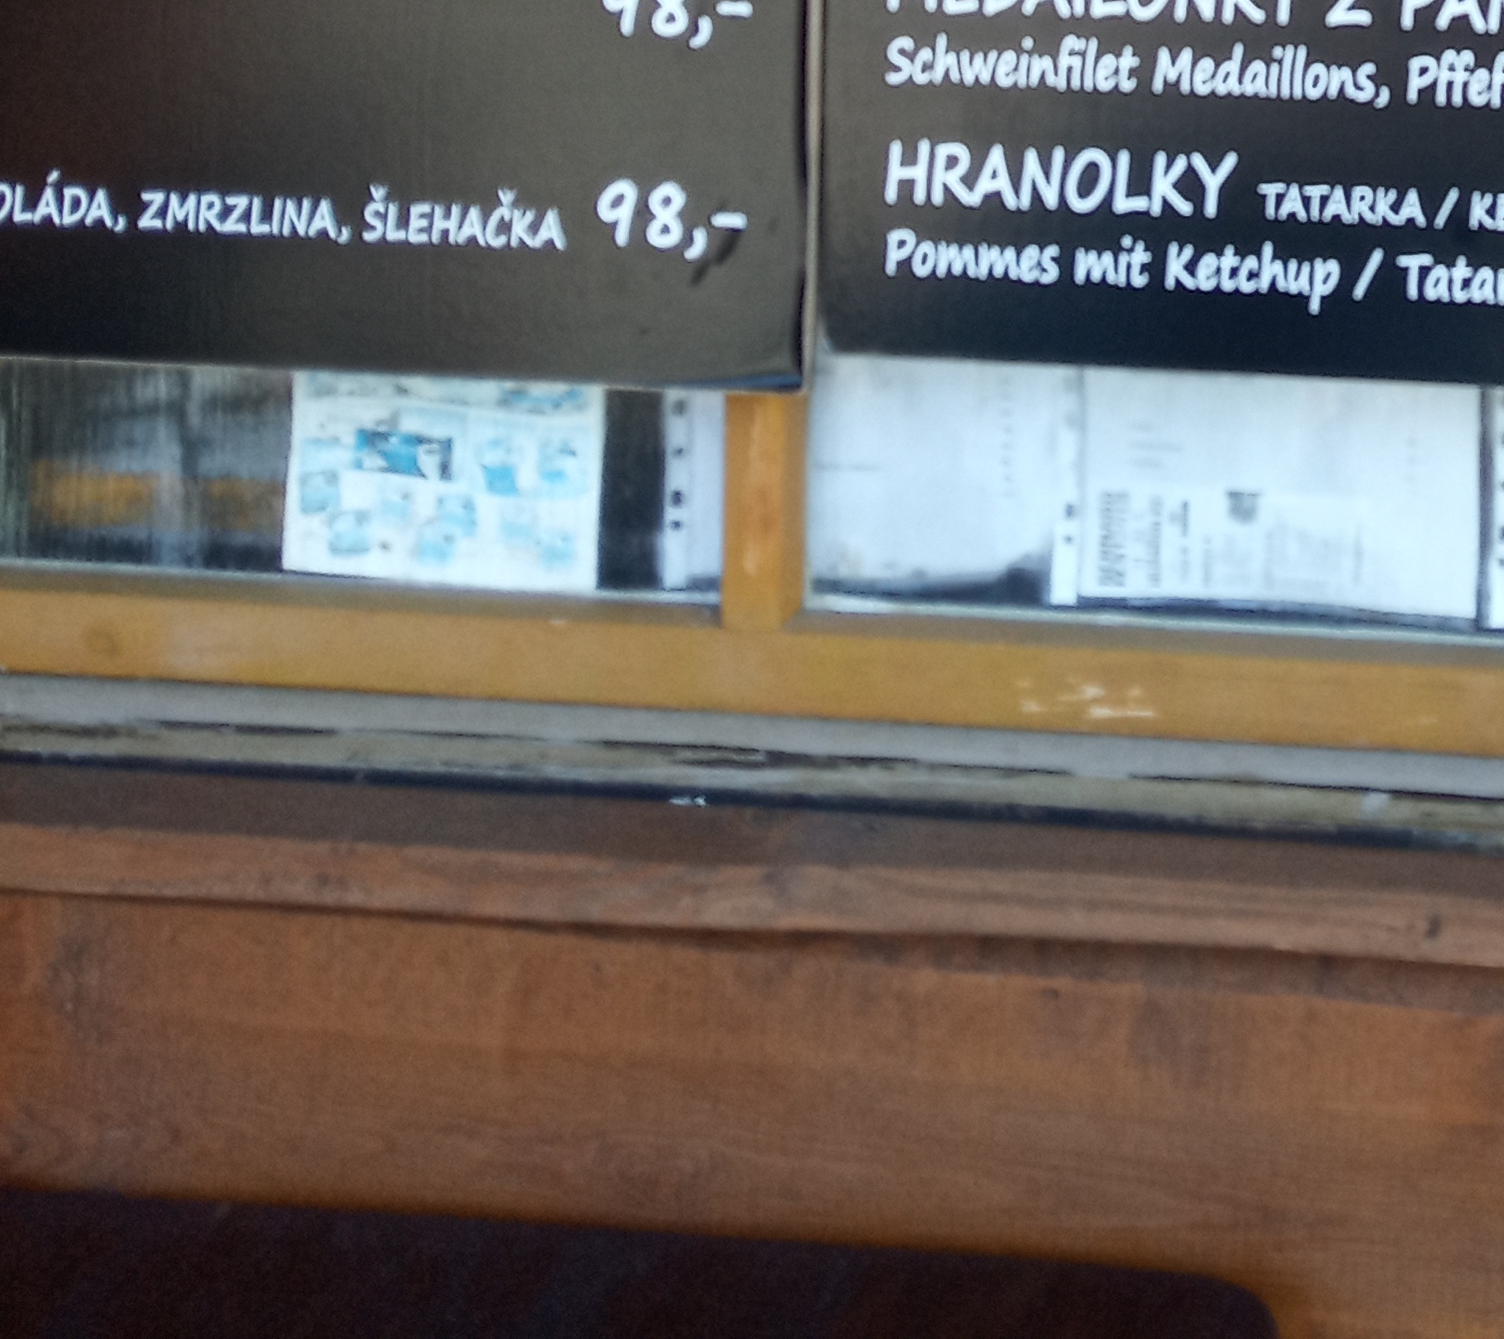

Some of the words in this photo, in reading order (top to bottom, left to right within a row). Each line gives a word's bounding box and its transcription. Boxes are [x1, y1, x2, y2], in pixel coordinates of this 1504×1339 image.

[884, 32, 1141, 93] Schweinfilet
[1151, 42, 1391, 109] Medaillons,
[136, 189, 352, 245] ZMRZLINA,
[361, 184, 567, 251] ŠLEHAČKA
[596, 178, 749, 261] 98,-
[883, 138, 1239, 219] HRANOLKY
[1257, 181, 1427, 228] TATARKA
[884, 226, 1060, 285] Pommes
[1073, 234, 1152, 289] mit
[1164, 240, 1341, 315] Ketchup
